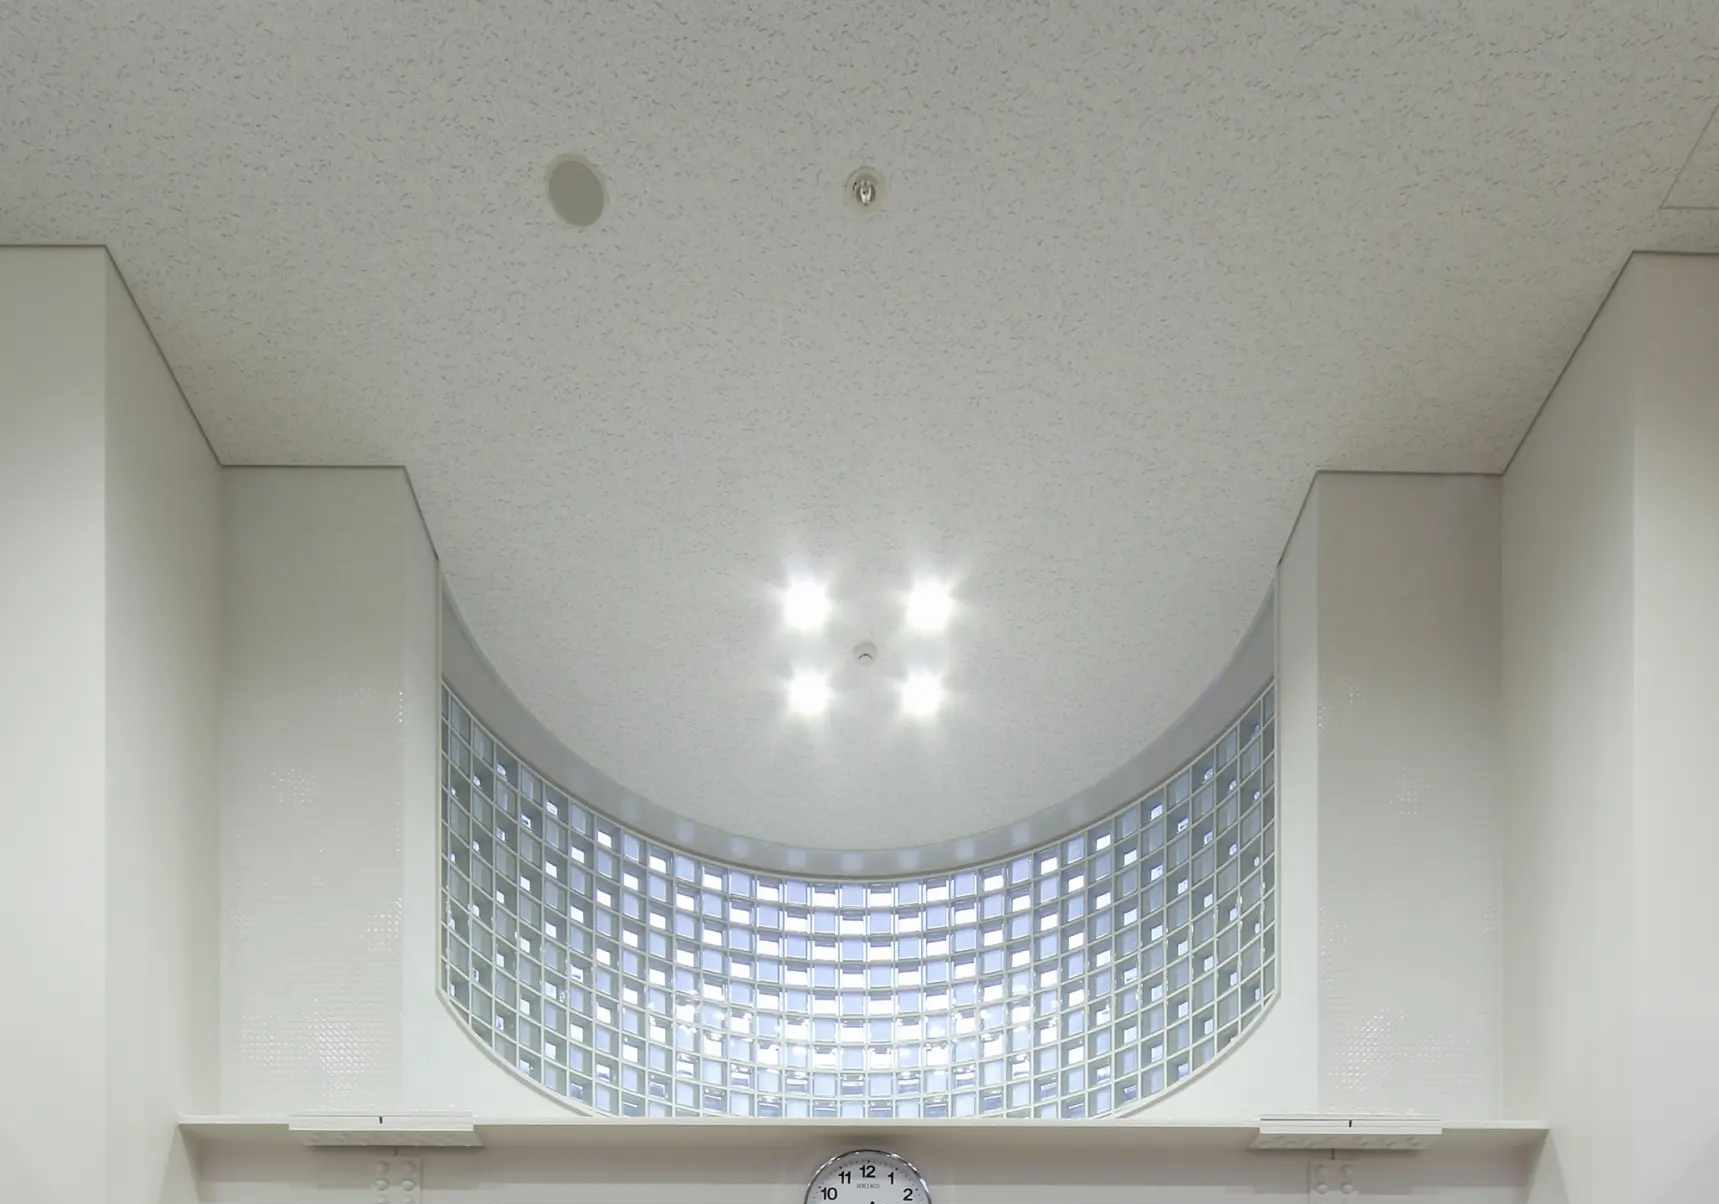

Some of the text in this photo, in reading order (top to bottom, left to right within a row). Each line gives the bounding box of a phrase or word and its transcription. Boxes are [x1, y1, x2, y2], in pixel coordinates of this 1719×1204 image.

[838, 1171, 851, 1184] 11
[859, 1165, 876, 1178] 12
[887, 1172, 894, 1185] 1
[820, 1187, 838, 1200] 10
[902, 1188, 913, 1201] 2
